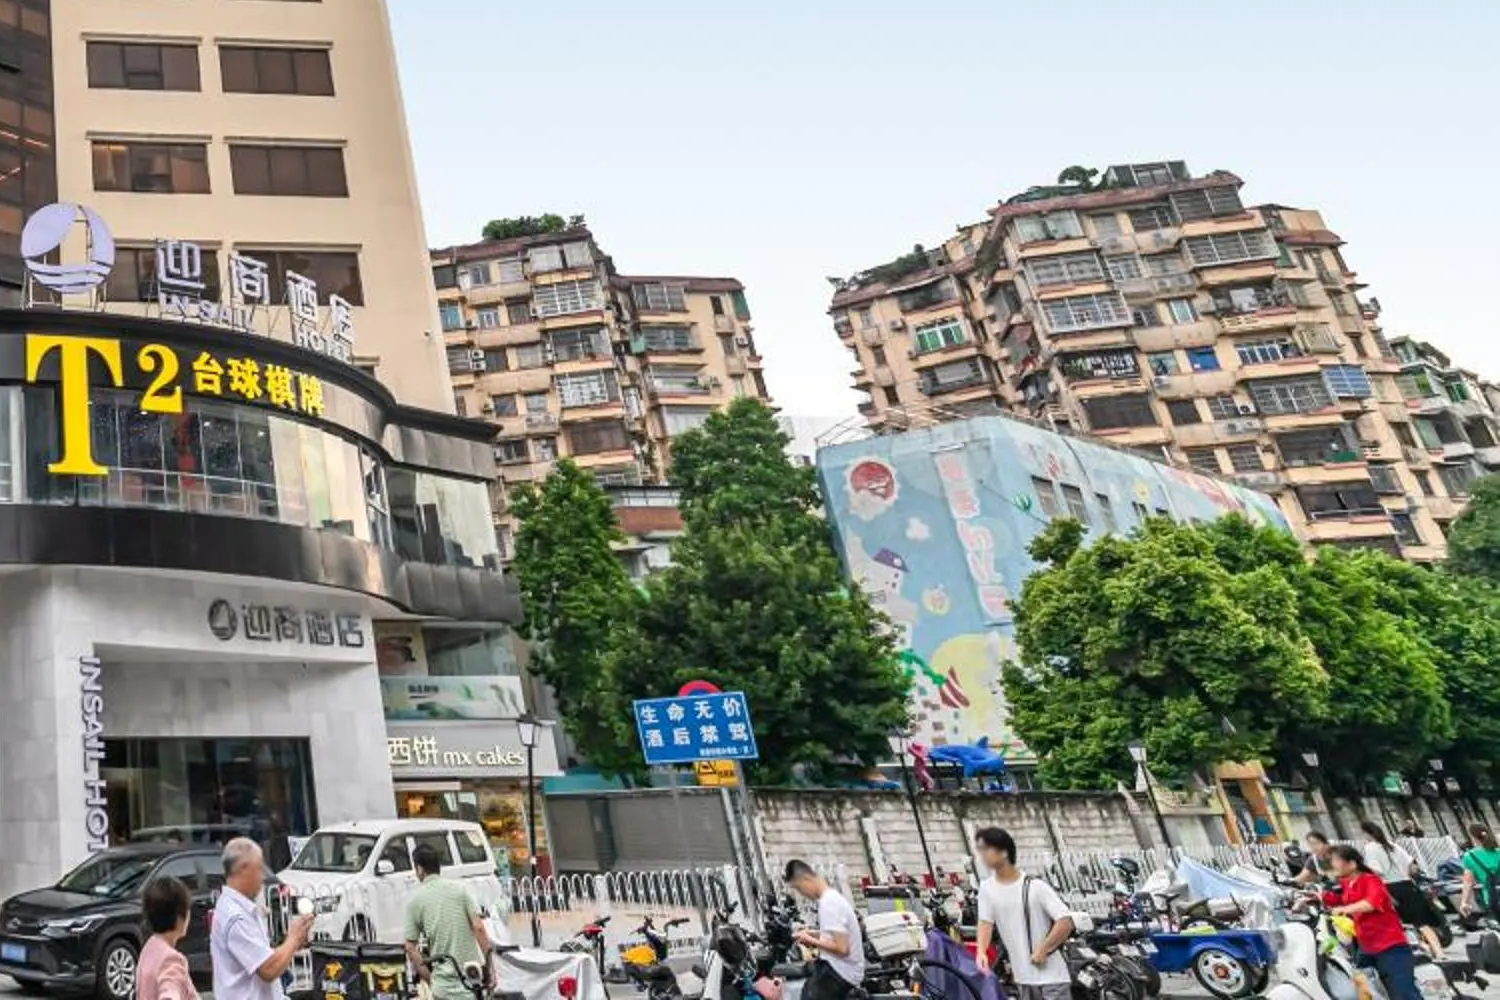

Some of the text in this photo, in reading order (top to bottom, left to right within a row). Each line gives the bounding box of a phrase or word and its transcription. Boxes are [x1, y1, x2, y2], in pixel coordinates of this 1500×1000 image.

[241, 603, 364, 648] 迎商酒店
[641, 698, 741, 724] 生命无价
[645, 723, 749, 748] 酒后禁驾
[443, 751, 472, 765] mx
[476, 745, 525, 765] cakes
